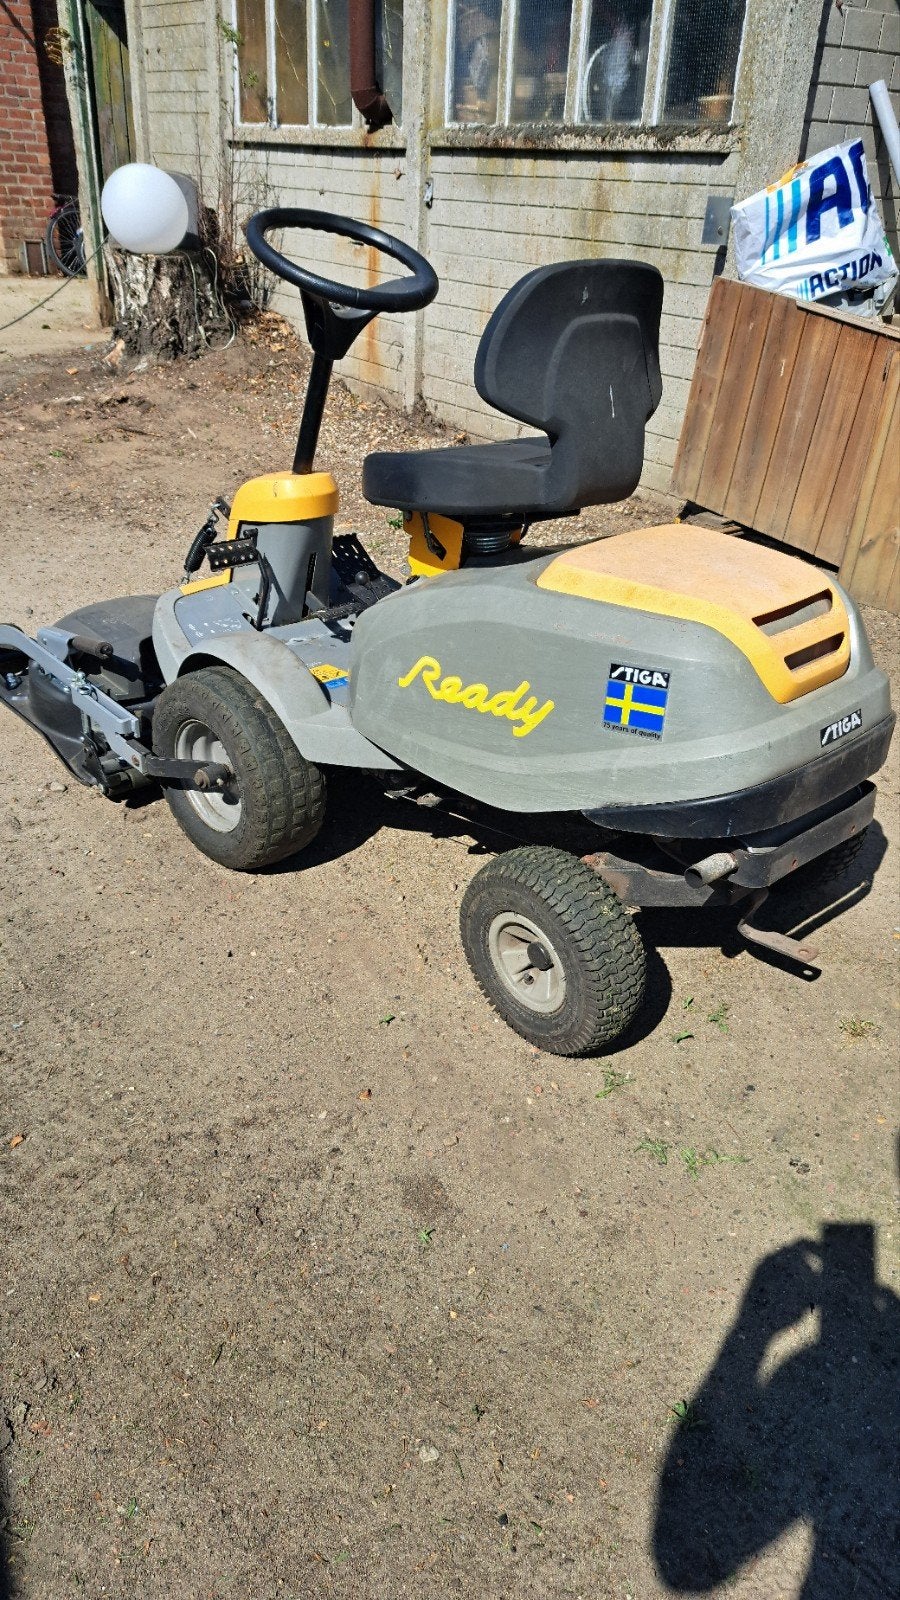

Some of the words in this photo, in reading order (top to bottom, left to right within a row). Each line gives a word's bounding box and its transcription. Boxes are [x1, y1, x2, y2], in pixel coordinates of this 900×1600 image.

[809, 250, 883, 298] ACTION
[611, 666, 667, 687] STIGA
[398, 655, 555, 738] Ready
[603, 721, 611, 729] 75
[611, 725, 629, 733] years
[638, 730, 661, 740] quality
[821, 713, 861, 745] STIGA
